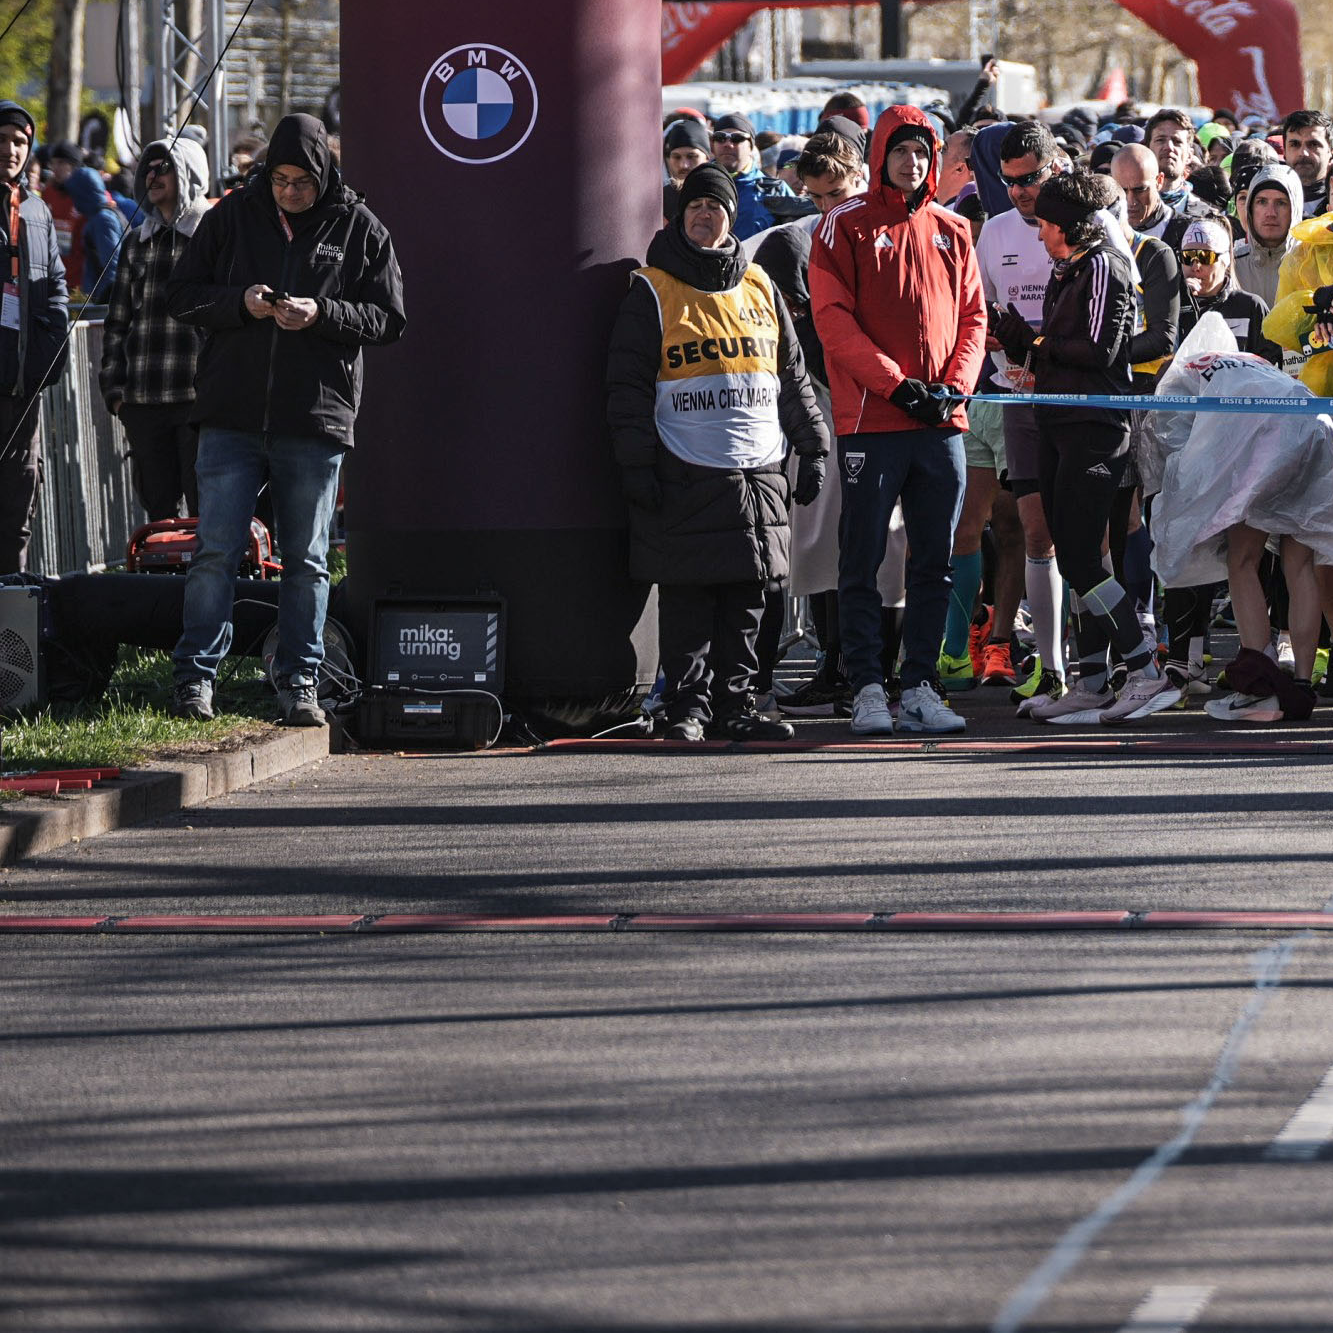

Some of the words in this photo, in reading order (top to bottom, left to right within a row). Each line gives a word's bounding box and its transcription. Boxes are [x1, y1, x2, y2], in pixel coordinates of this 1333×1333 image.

[435, 49, 522, 84] BMW
[316, 248, 344, 261] timing
[318, 242, 342, 253] mika:
[666, 336, 778, 369] SECURIT
[1282, 352, 1309, 366] nathan
[671, 389, 716, 413] VIENNA
[718, 387, 744, 409] CITY
[1110, 395, 1133, 403] ERSTE
[1144, 396, 1190, 404] SPARKASSE
[1220, 397, 1244, 405] ERSTE
[1254, 398, 1300, 406] SPARKASSE
[400, 624, 455, 642] mika:
[400, 641, 462, 661] timing
